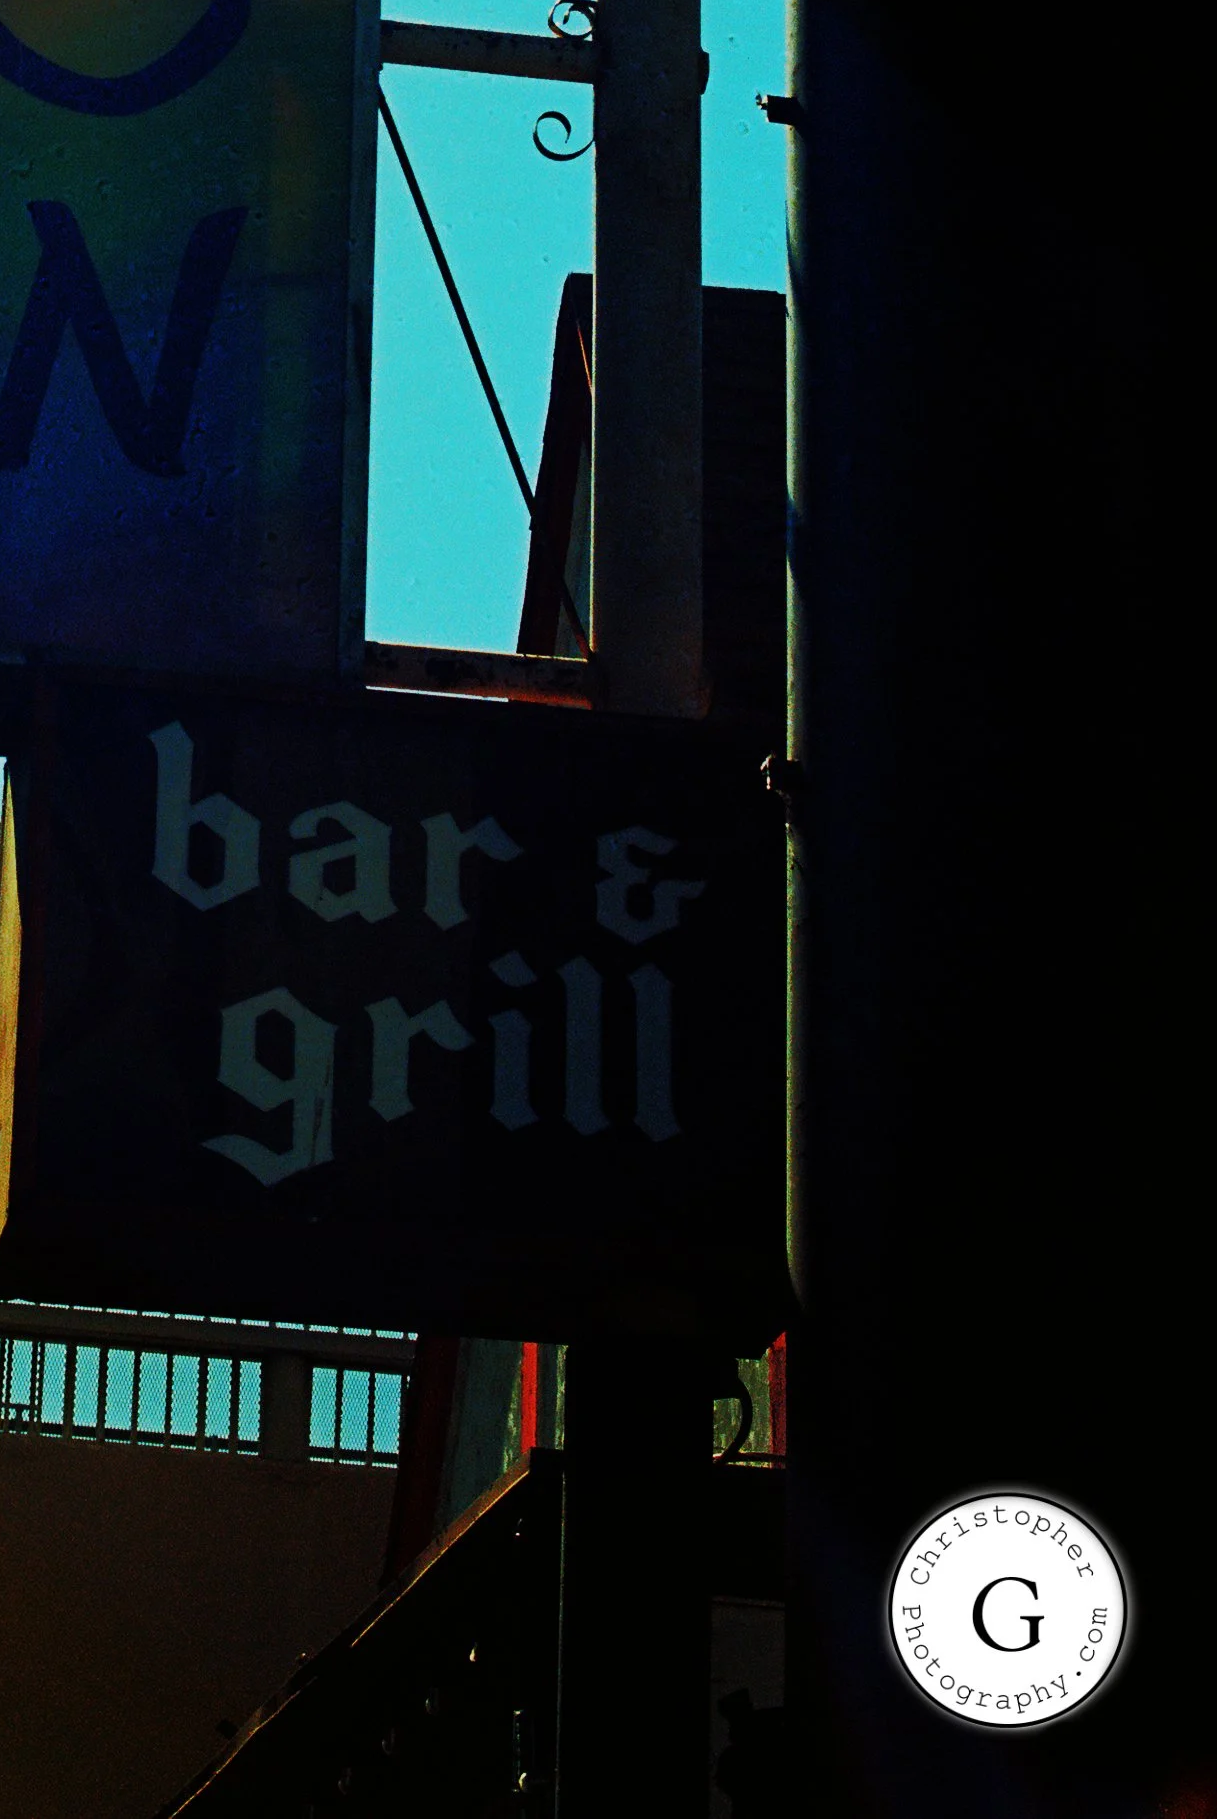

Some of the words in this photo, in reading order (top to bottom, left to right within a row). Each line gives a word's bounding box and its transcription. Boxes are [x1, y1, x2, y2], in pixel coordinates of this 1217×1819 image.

[147, 719, 525, 931] bar
[595, 824, 708, 945] &
[200, 949, 683, 1187] grill
